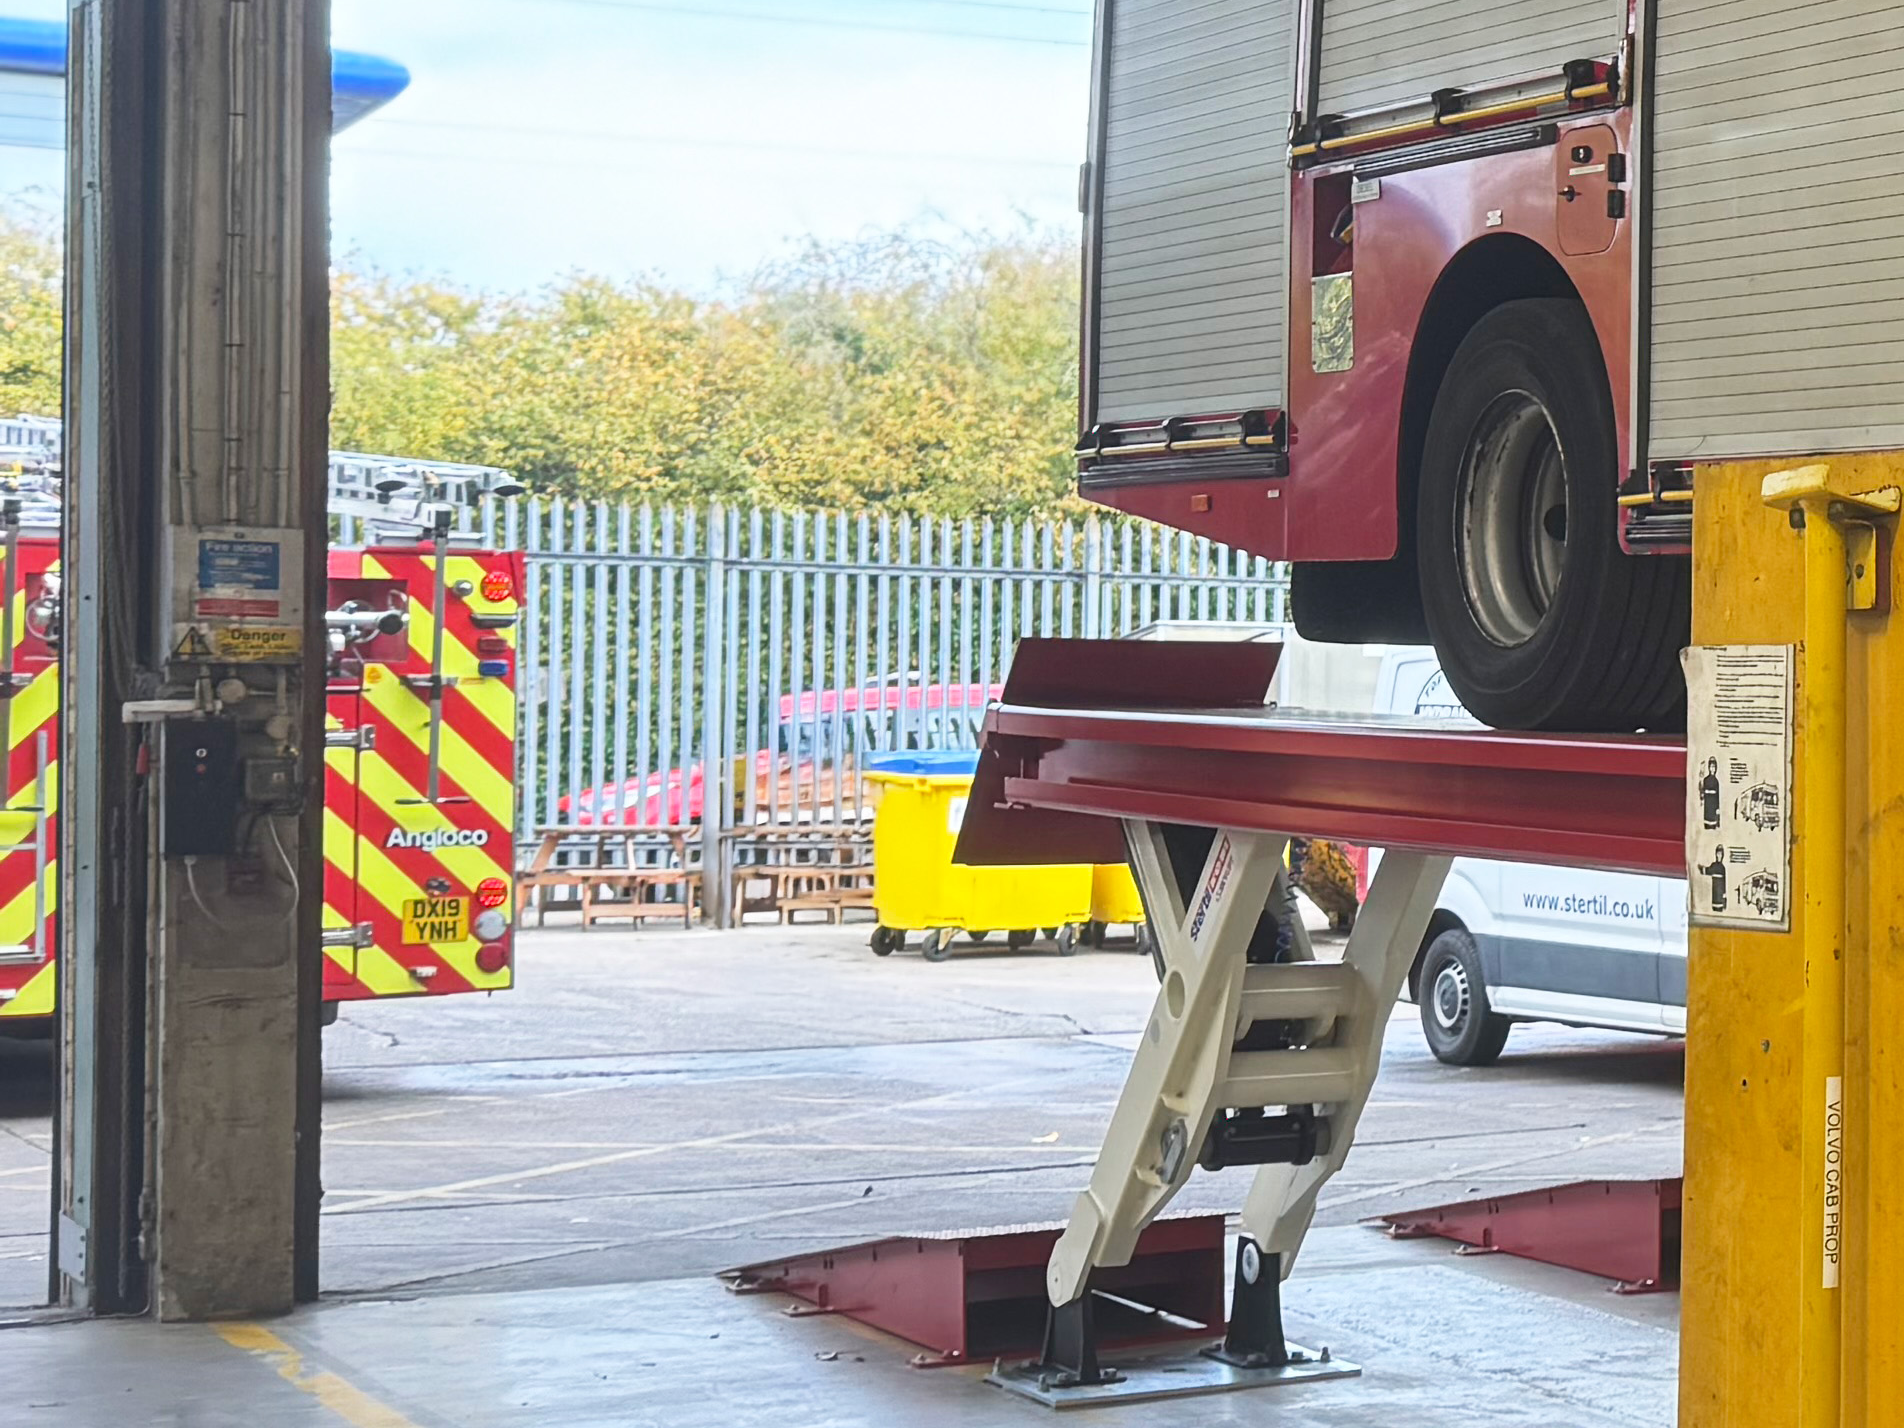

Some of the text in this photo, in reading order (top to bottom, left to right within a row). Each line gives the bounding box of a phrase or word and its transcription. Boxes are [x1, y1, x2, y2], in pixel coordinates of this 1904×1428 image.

[231, 629, 286, 643] Danger
[386, 827, 489, 852] Angloco
[413, 899, 460, 918] DX19
[1523, 893, 1654, 920] www.stertil.co.uk
[415, 921, 457, 940] YNH
[1824, 1101, 1841, 1264] VOLVO CAB PROP
